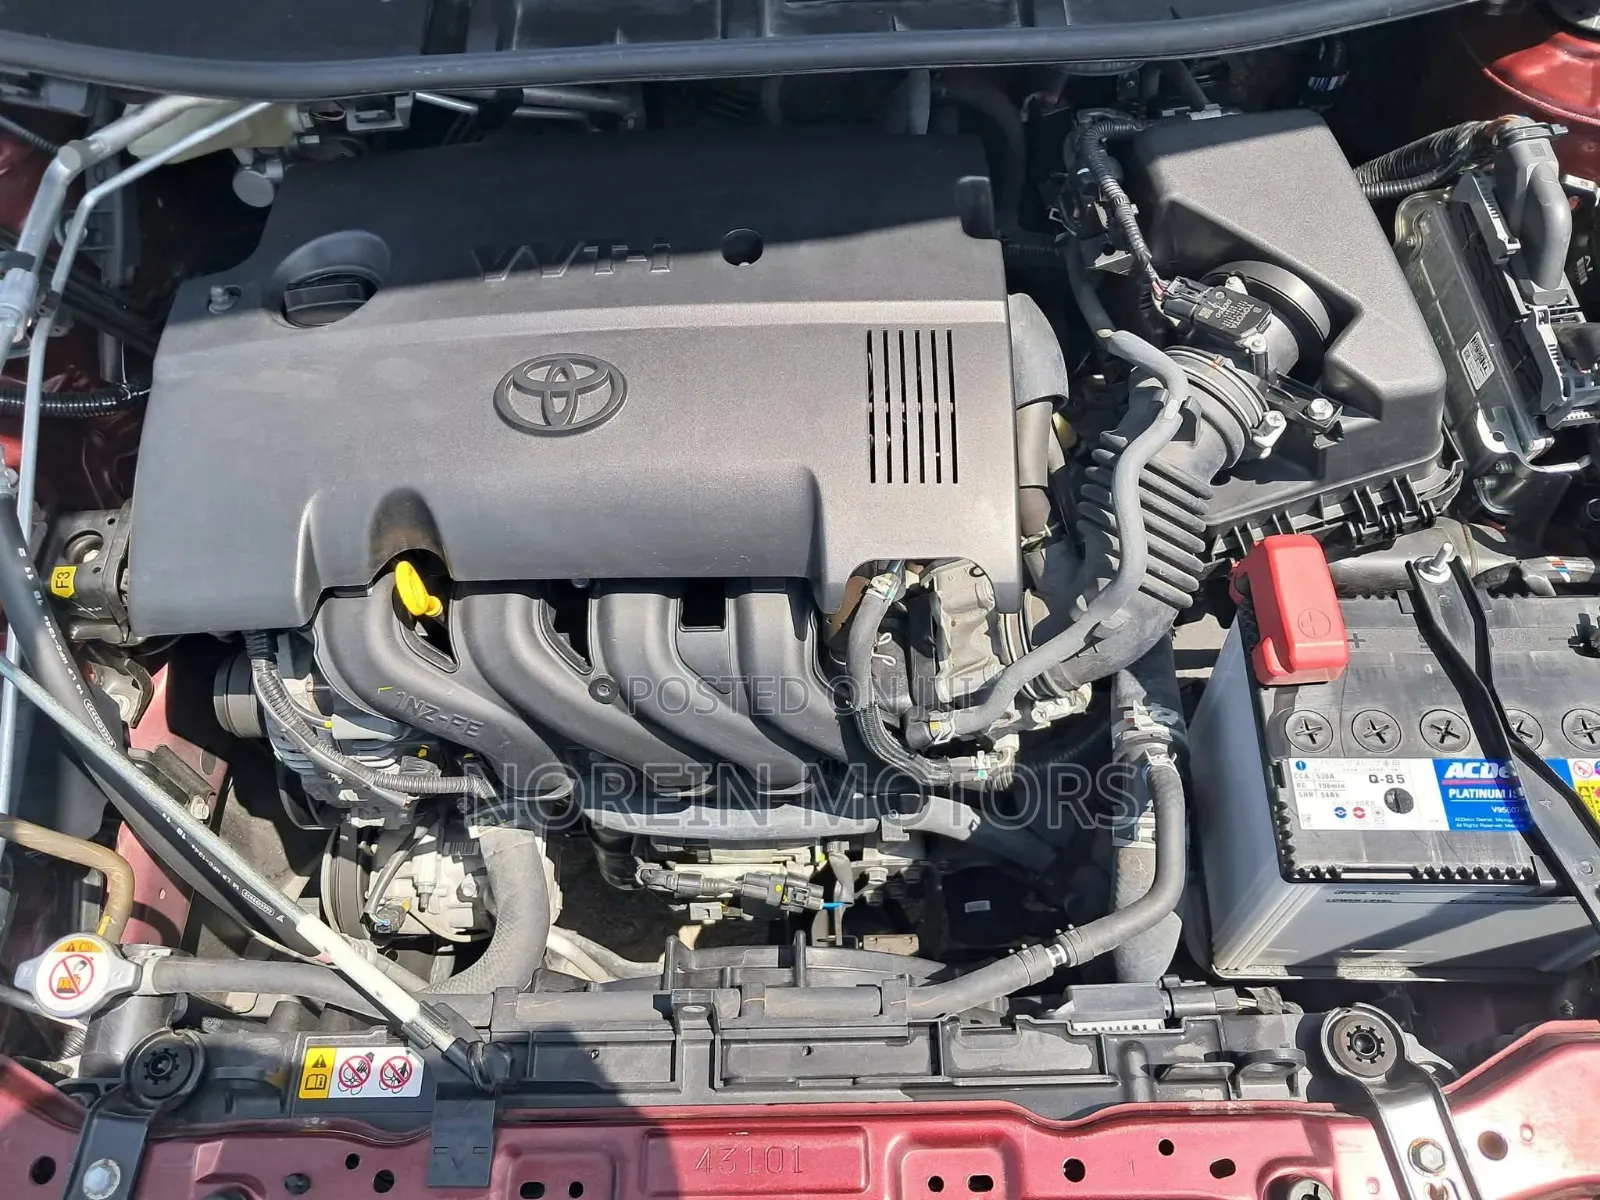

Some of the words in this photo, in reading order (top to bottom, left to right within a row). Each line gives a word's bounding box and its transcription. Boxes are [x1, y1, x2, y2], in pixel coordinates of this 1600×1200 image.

[1215, 298, 1232, 318] DENSO
[1229, 303, 1254, 329] TOYOTA
[55, 571, 70, 589] F3
[396, 691, 485, 738] 1NZ-FE
[1369, 774, 1405, 784] Q-85
[1449, 788, 1505, 799] PLATINUM
[695, 1145, 804, 1175] 43101
